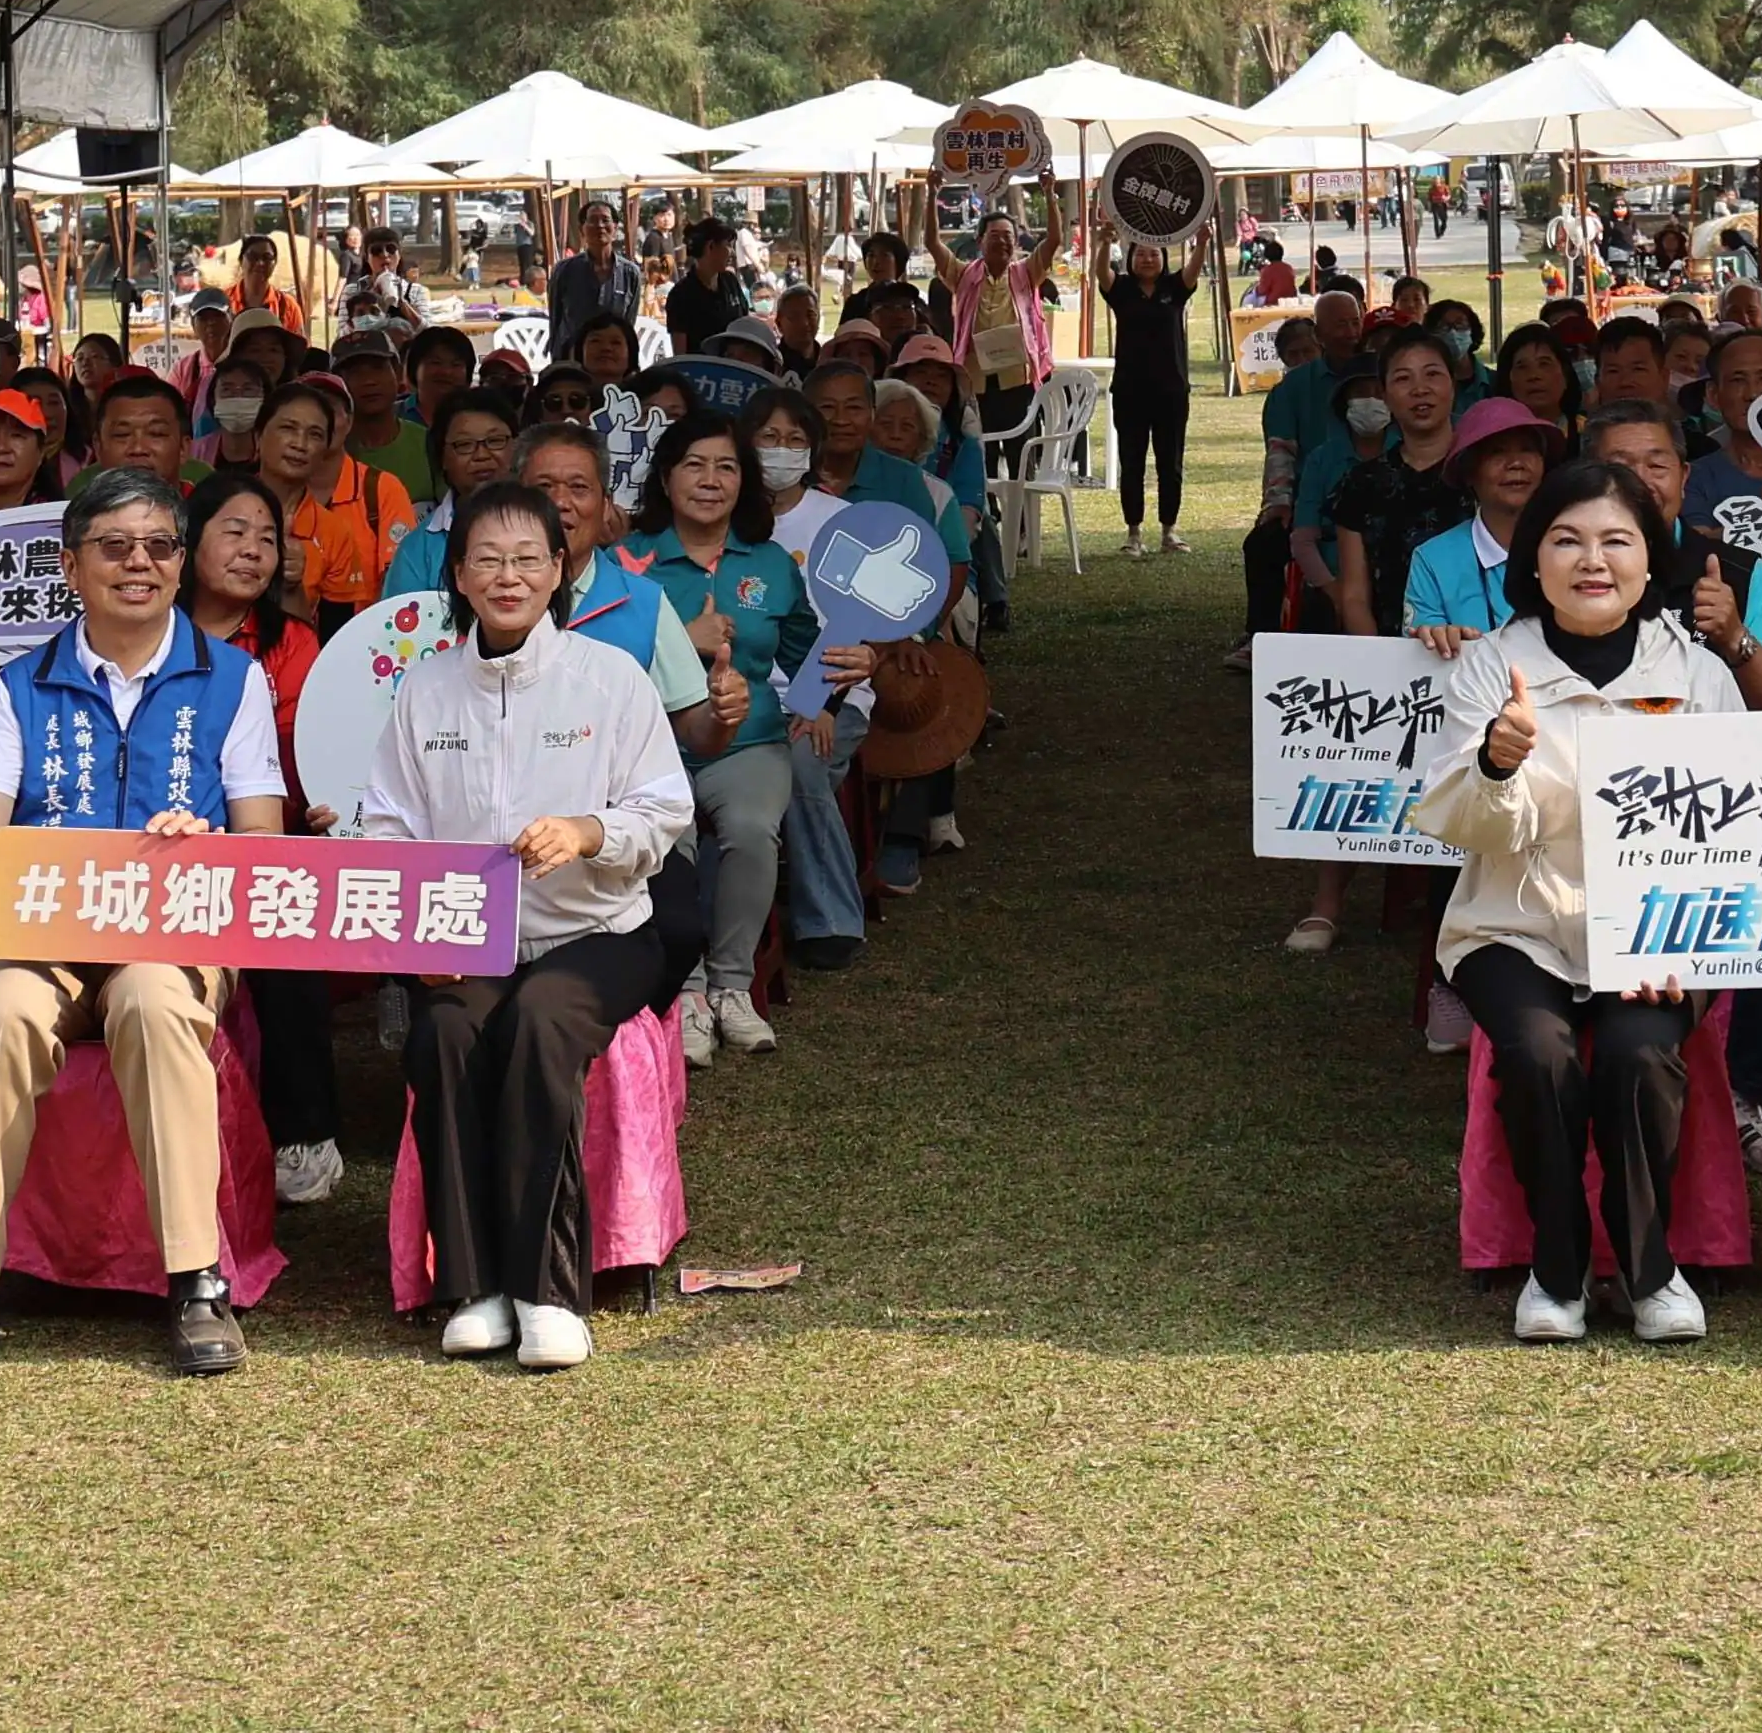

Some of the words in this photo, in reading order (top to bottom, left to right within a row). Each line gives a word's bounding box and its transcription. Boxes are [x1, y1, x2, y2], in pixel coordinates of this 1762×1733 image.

[1121, 176, 1192, 216] 金牌農村
[44, 713, 62, 751] 處長
[1263, 675, 1446, 773] 雲林上場
[73, 710, 96, 816] 城鄉發展處
[424, 739, 469, 753] MIZUNO
[1280, 744, 1310, 760] It's
[1315, 745, 1347, 761] Our
[1351, 746, 1391, 762] Time
[1337, 837, 1434, 857] Yunlin@Top
[1618, 849, 1654, 867] It's
[1660, 848, 1698, 866] Our
[1702, 846, 1752, 865] Time
[13, 859, 489, 947] #城鄉發展處
